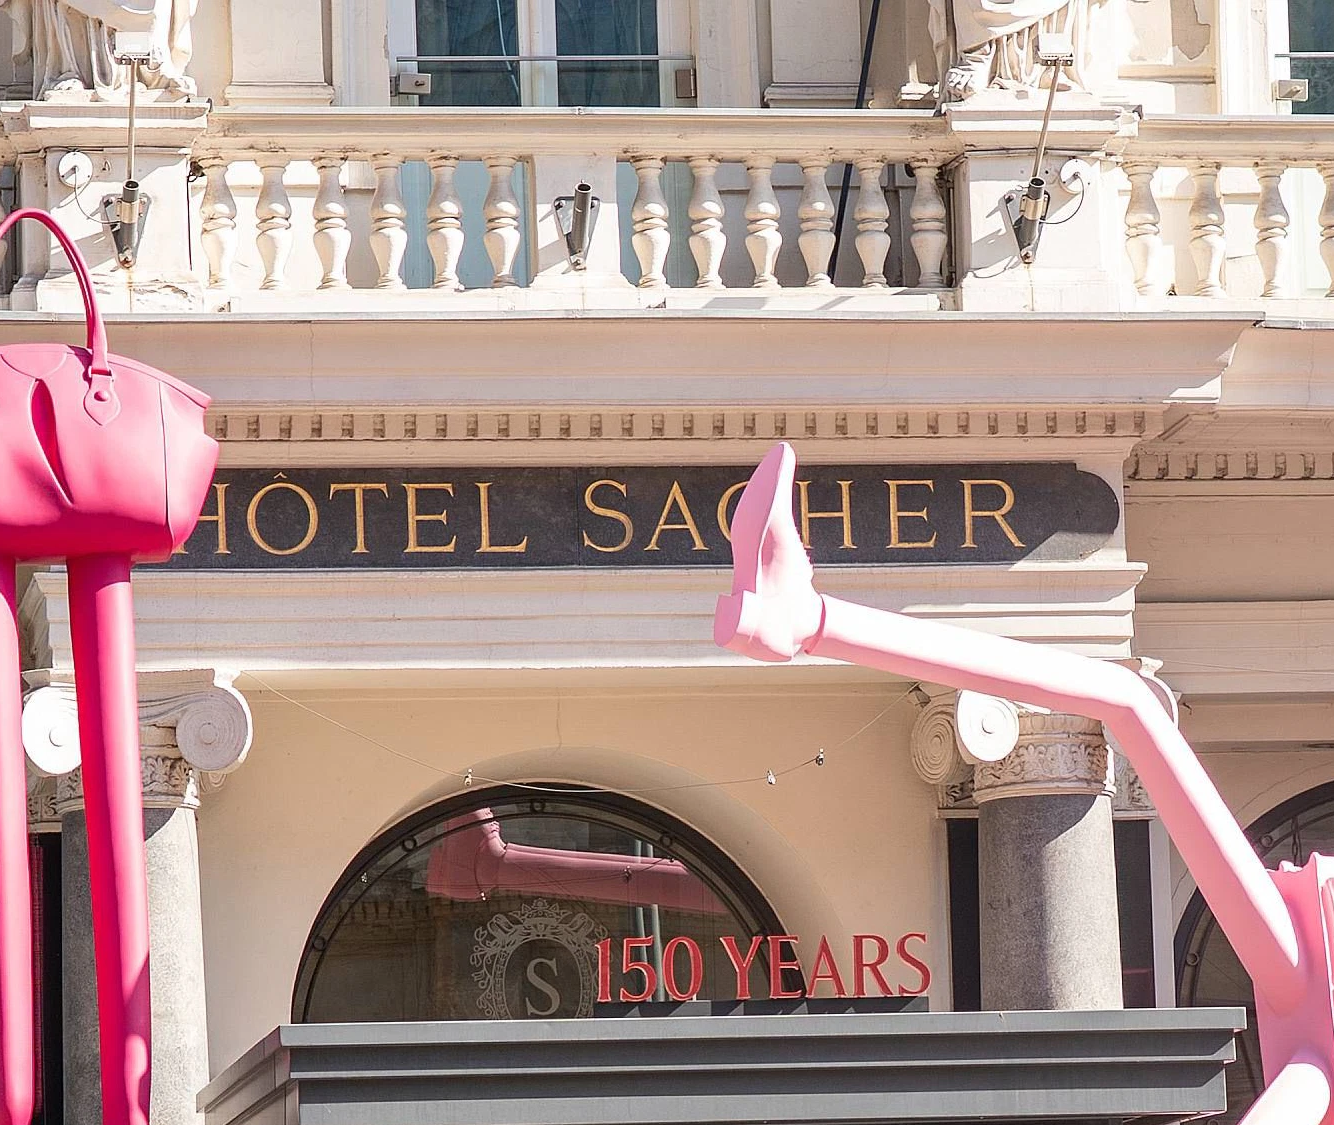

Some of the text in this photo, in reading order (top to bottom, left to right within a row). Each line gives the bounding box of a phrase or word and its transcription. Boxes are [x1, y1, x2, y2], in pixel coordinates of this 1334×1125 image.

[525, 957, 561, 1017] S
[594, 932, 933, 1003] 150 YEARS
